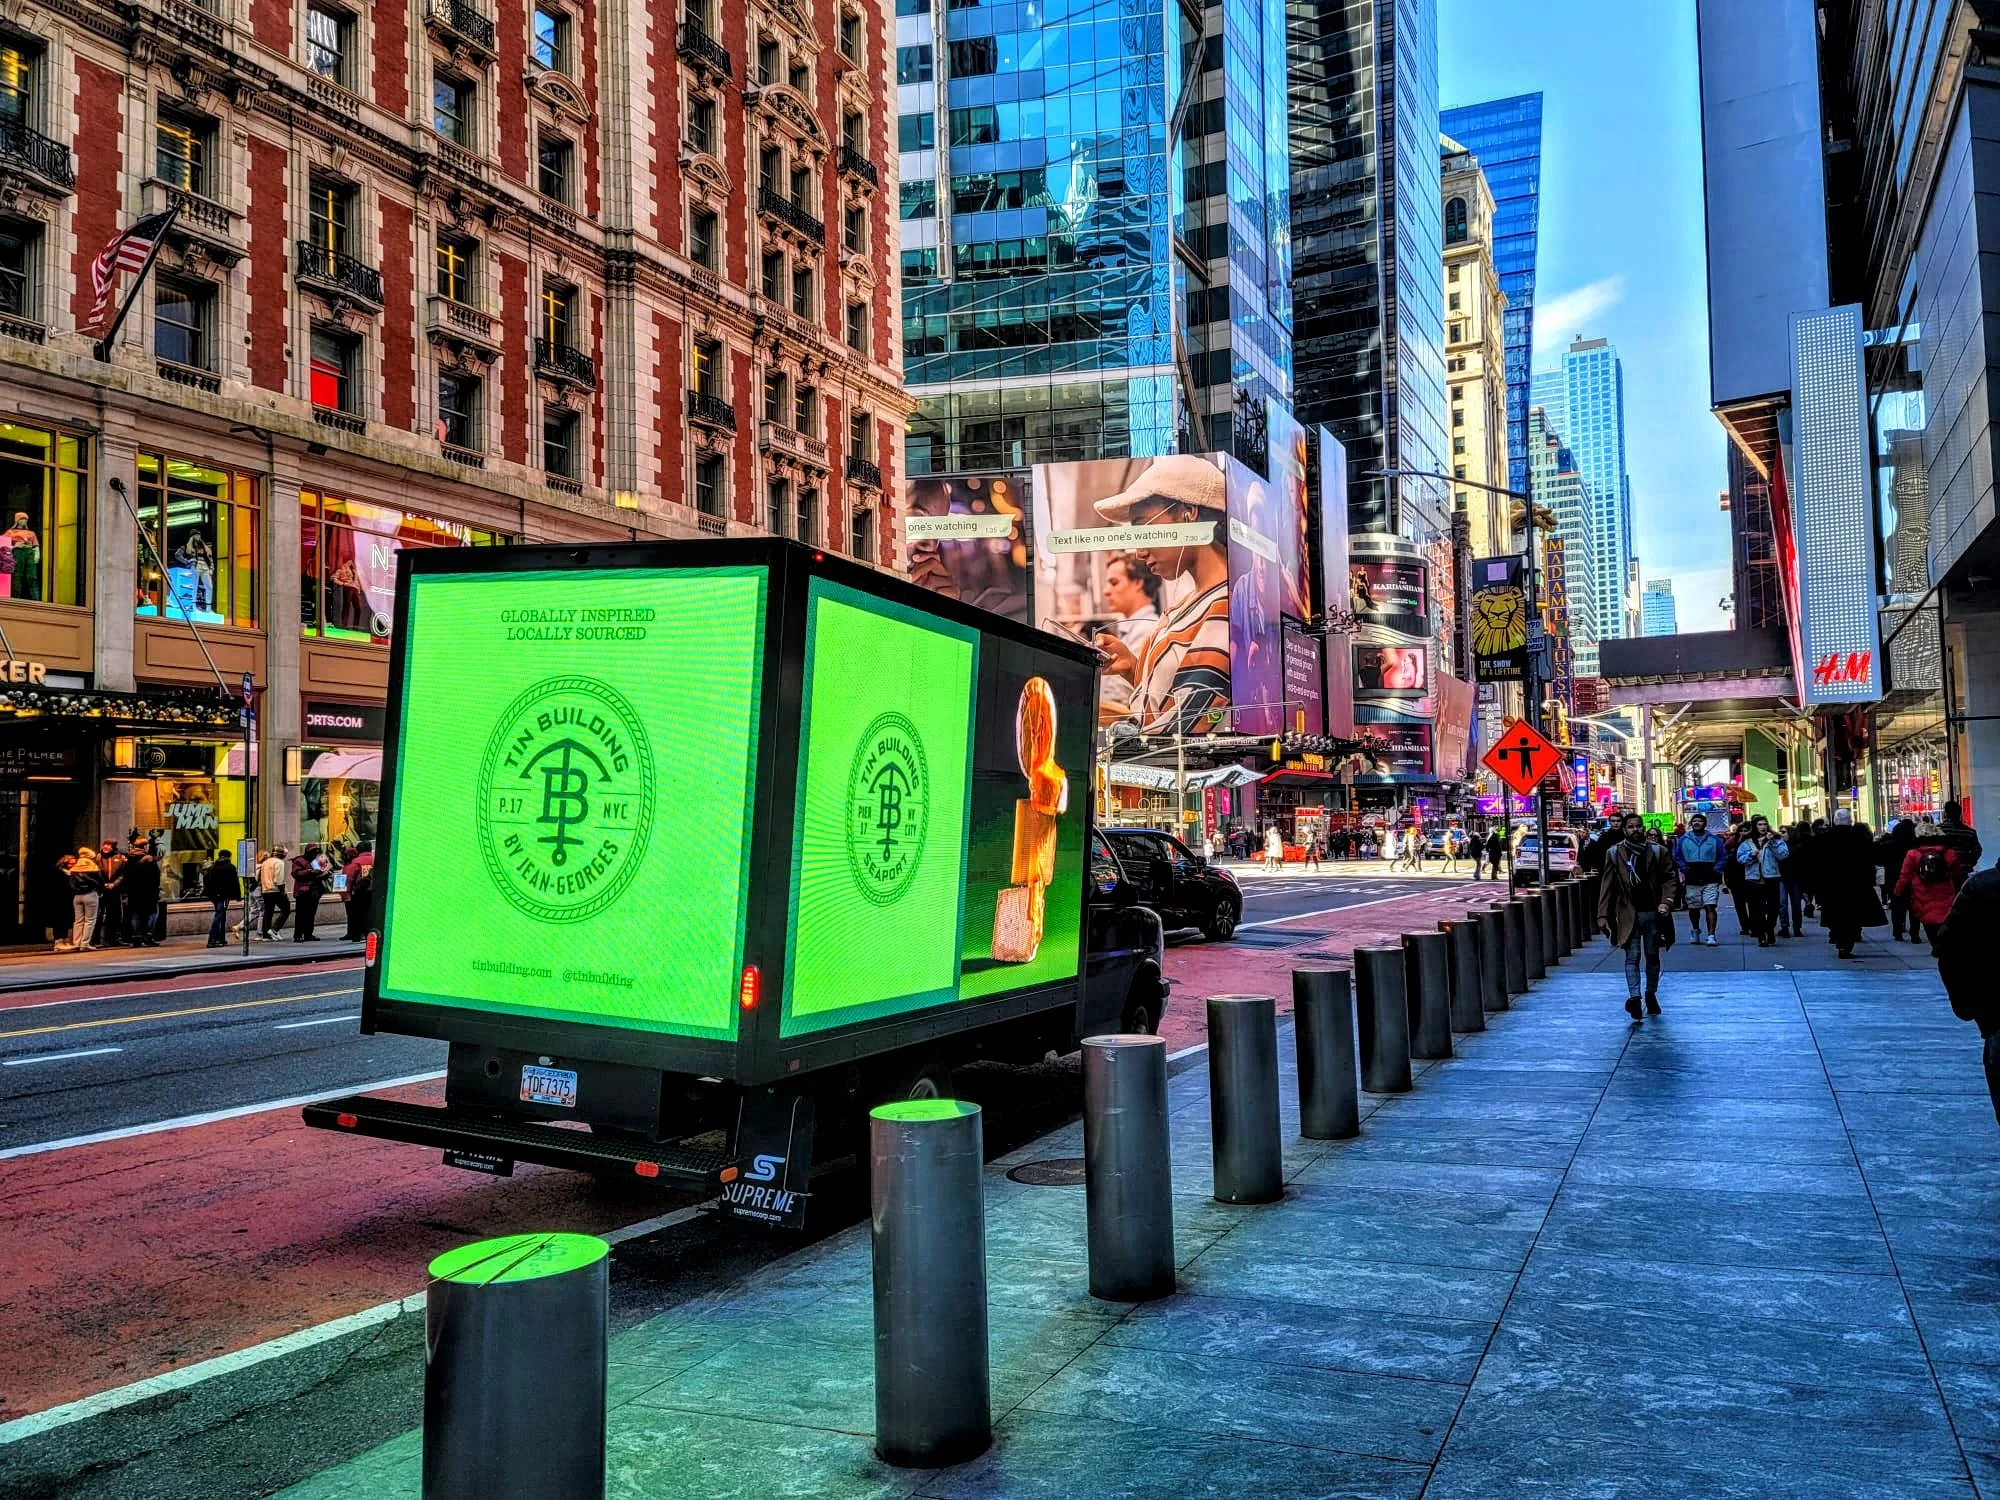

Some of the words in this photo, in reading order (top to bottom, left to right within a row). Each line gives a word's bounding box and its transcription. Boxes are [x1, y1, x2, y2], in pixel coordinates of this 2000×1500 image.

[908, 522, 933, 532] one's
[934, 521, 978, 532] watching
[1053, 536, 1073, 546] Text
[1074, 534, 1092, 545] like
[1093, 535, 1105, 543] no
[1107, 532, 1132, 542] one's
[1134, 529, 1179, 541] watching
[1549, 540, 1565, 621] MADAME
[501, 609, 578, 623] GLOBALLY
[581, 608, 656, 622] INSPIRED
[506, 627, 573, 641] LOCALLY
[575, 626, 647, 641] SOURCED
[1480, 660, 1491, 668] THE
[1493, 660, 1511, 668] SHOW
[504, 728, 535, 768] TIN
[537, 707, 629, 773] BUILDING
[861, 752, 877, 785] TIN
[877, 736, 919, 790] BUILDING
[164, 803, 214, 818] JUMP
[499, 799, 523, 814] P.17
[603, 803, 629, 819] NYC
[858, 805, 872, 819] PIER
[176, 815, 219, 829] MAN
[908, 808, 916, 821] NY
[504, 834, 523, 857] BY
[517, 839, 619, 895] JEAN-GEORGES
[864, 852, 909, 882] SEAPORT
[472, 960, 553, 978] tinbuilding.com
[562, 969, 635, 989] @tinbuilding
[721, 1182, 795, 1213] SUPREME
[733, 1207, 782, 1222] supremecorp.com
